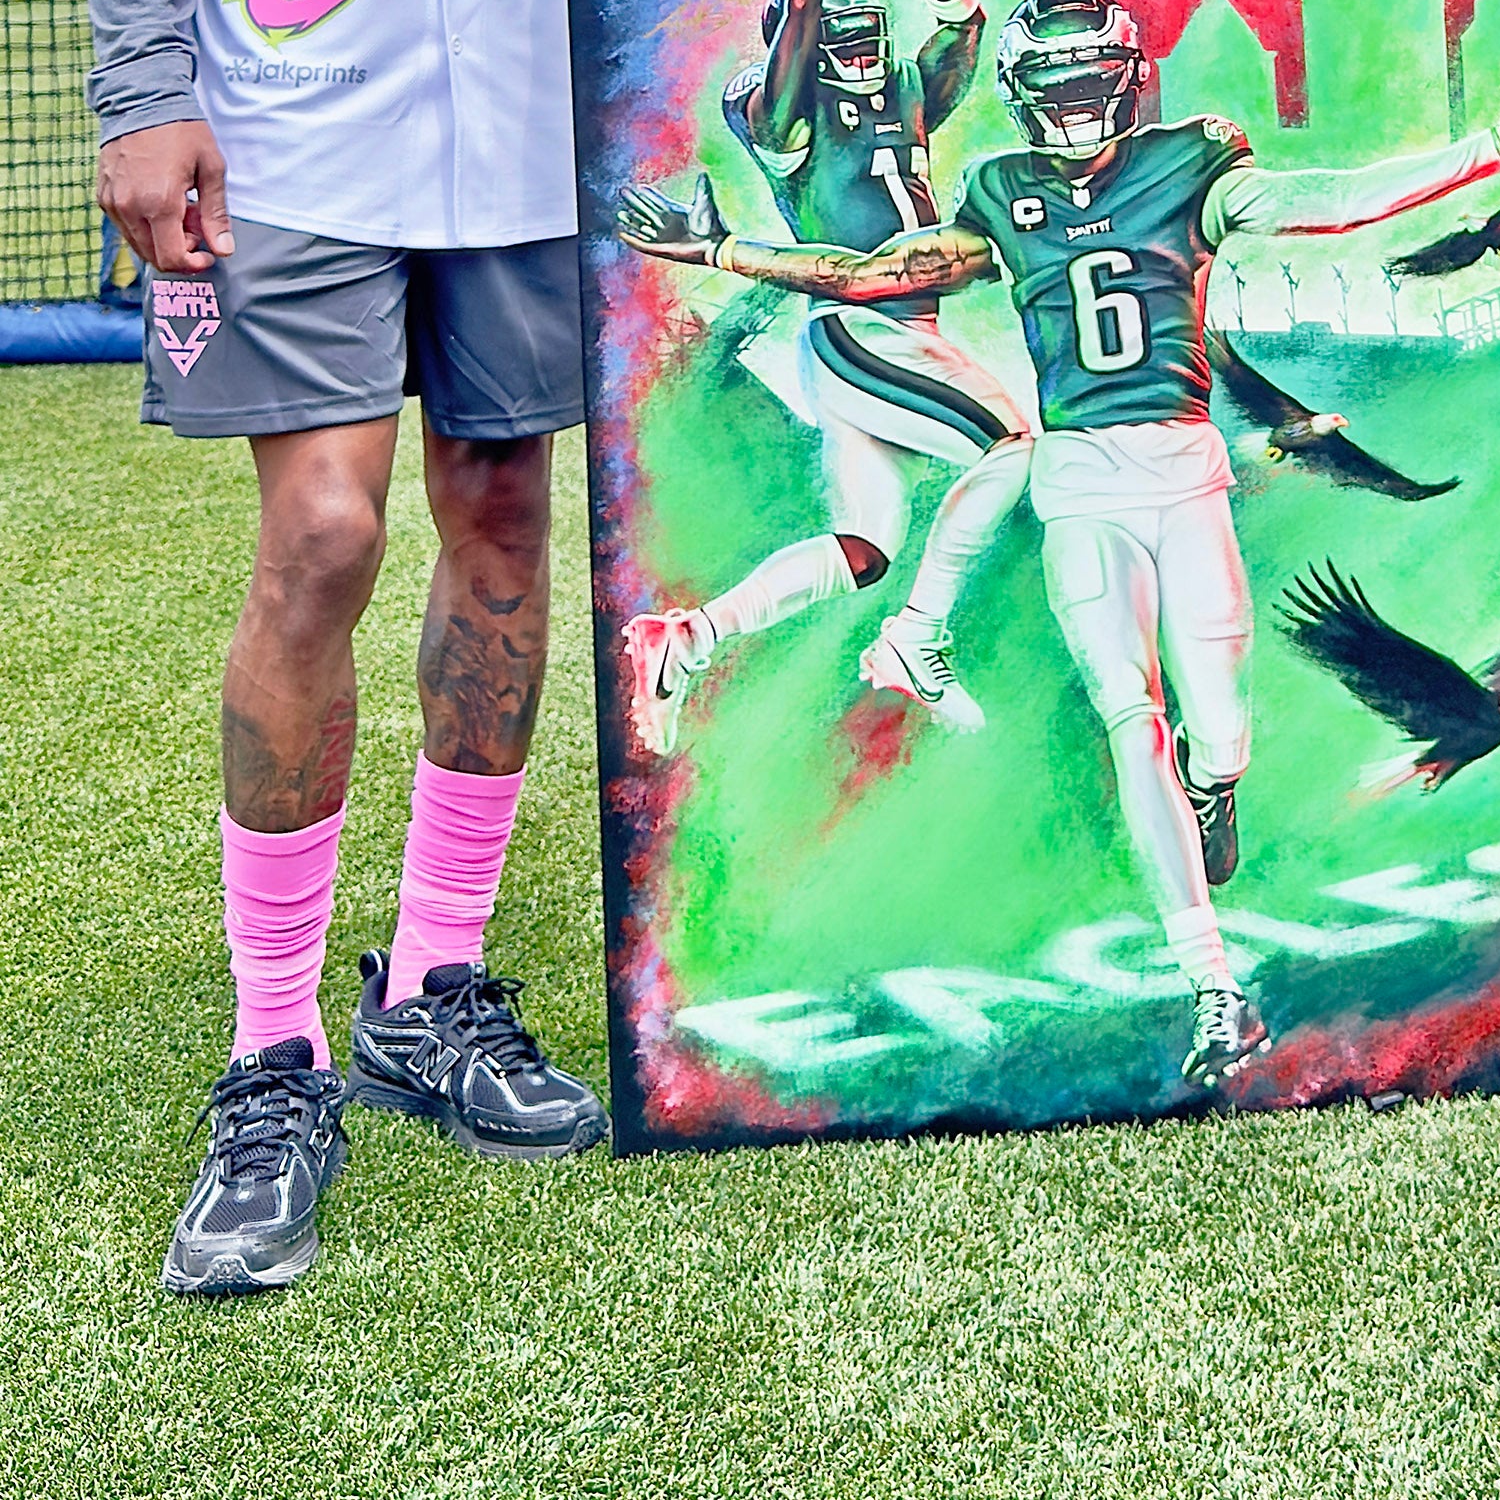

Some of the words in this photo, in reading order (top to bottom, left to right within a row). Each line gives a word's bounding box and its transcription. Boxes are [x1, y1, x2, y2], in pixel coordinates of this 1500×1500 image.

[254, 59, 368, 88] jakprints
[152, 279, 216, 296] DEVONTA
[153, 296, 221, 318] SMITH
[1068, 250, 1147, 372] 6
